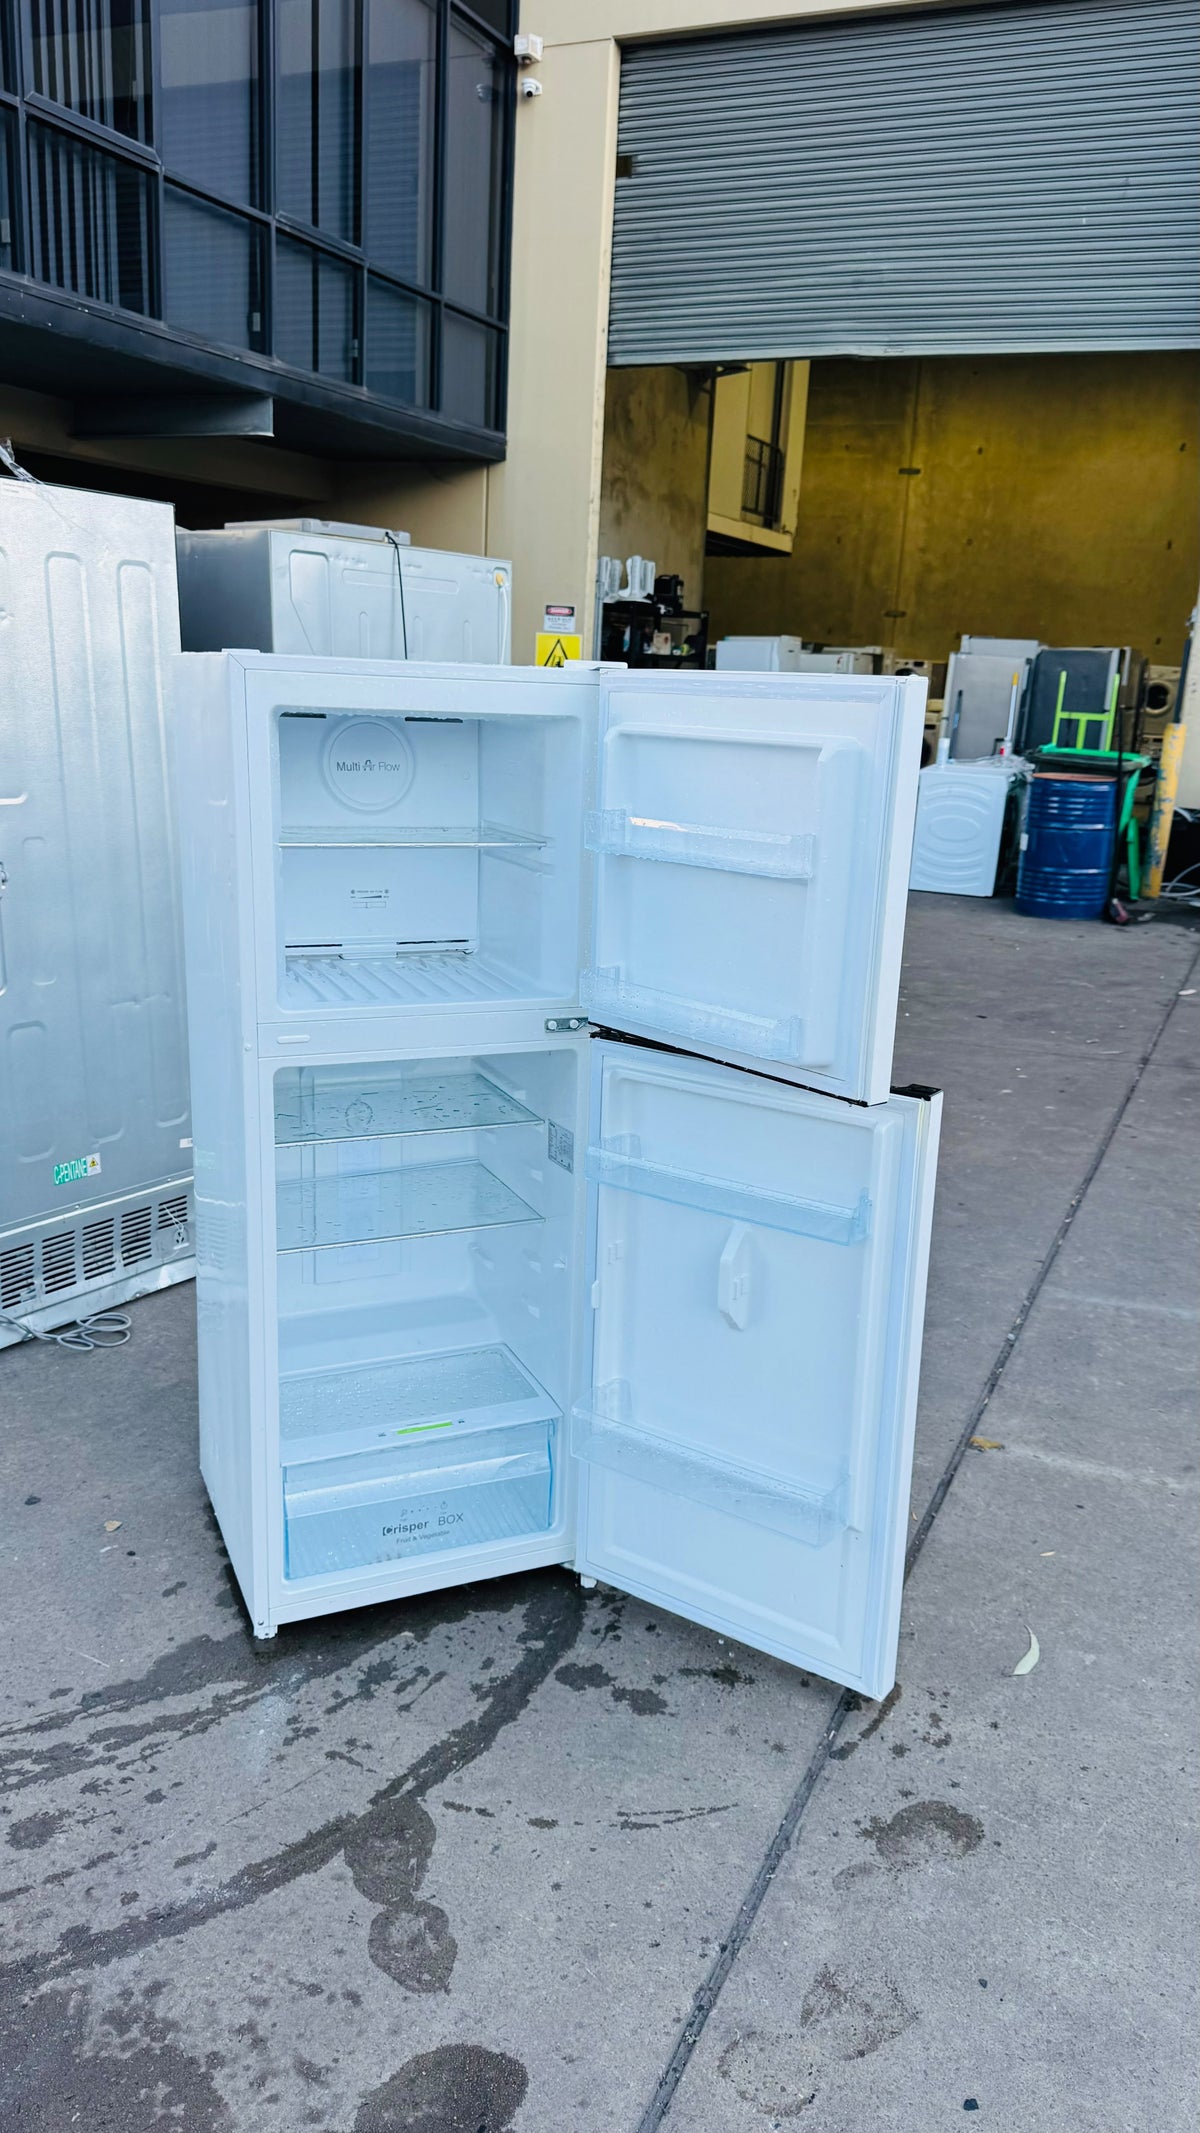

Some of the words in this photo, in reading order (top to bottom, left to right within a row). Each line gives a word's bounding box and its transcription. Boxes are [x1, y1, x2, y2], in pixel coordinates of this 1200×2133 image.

[336, 761, 361, 772] Multi
[378, 761, 401, 772] Flow
[53, 1158, 88, 1185] C-PENTANE
[382, 1520, 430, 1537] Crisper
[438, 1512, 465, 1527] BOX
